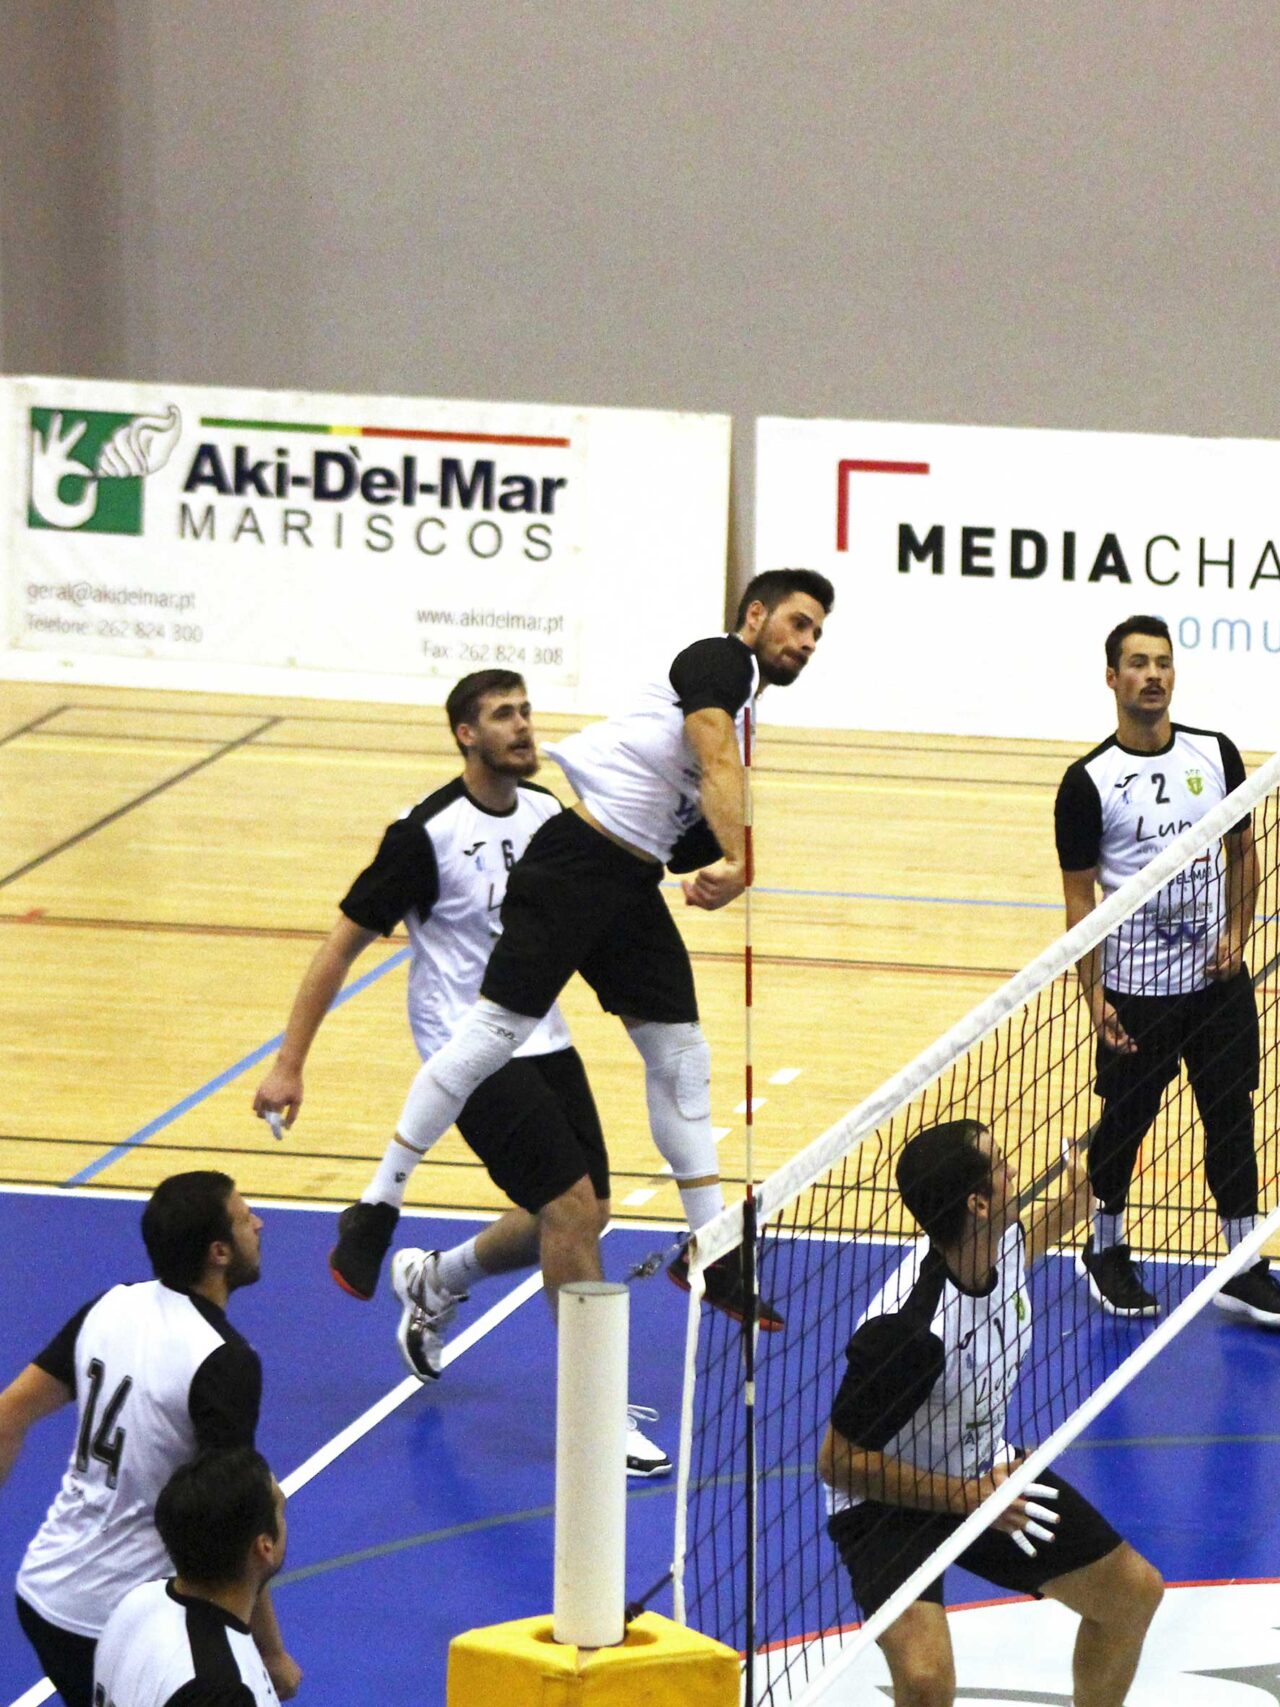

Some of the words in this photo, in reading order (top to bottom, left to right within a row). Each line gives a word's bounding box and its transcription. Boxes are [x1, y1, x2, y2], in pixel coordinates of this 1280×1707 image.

[177, 502, 554, 561] MARISCOS
[416, 607, 564, 635] www.akidelmar.pt
[1151, 772, 1171, 805] 2
[501, 839, 516, 871] 6
[75, 1357, 133, 1490] 14
